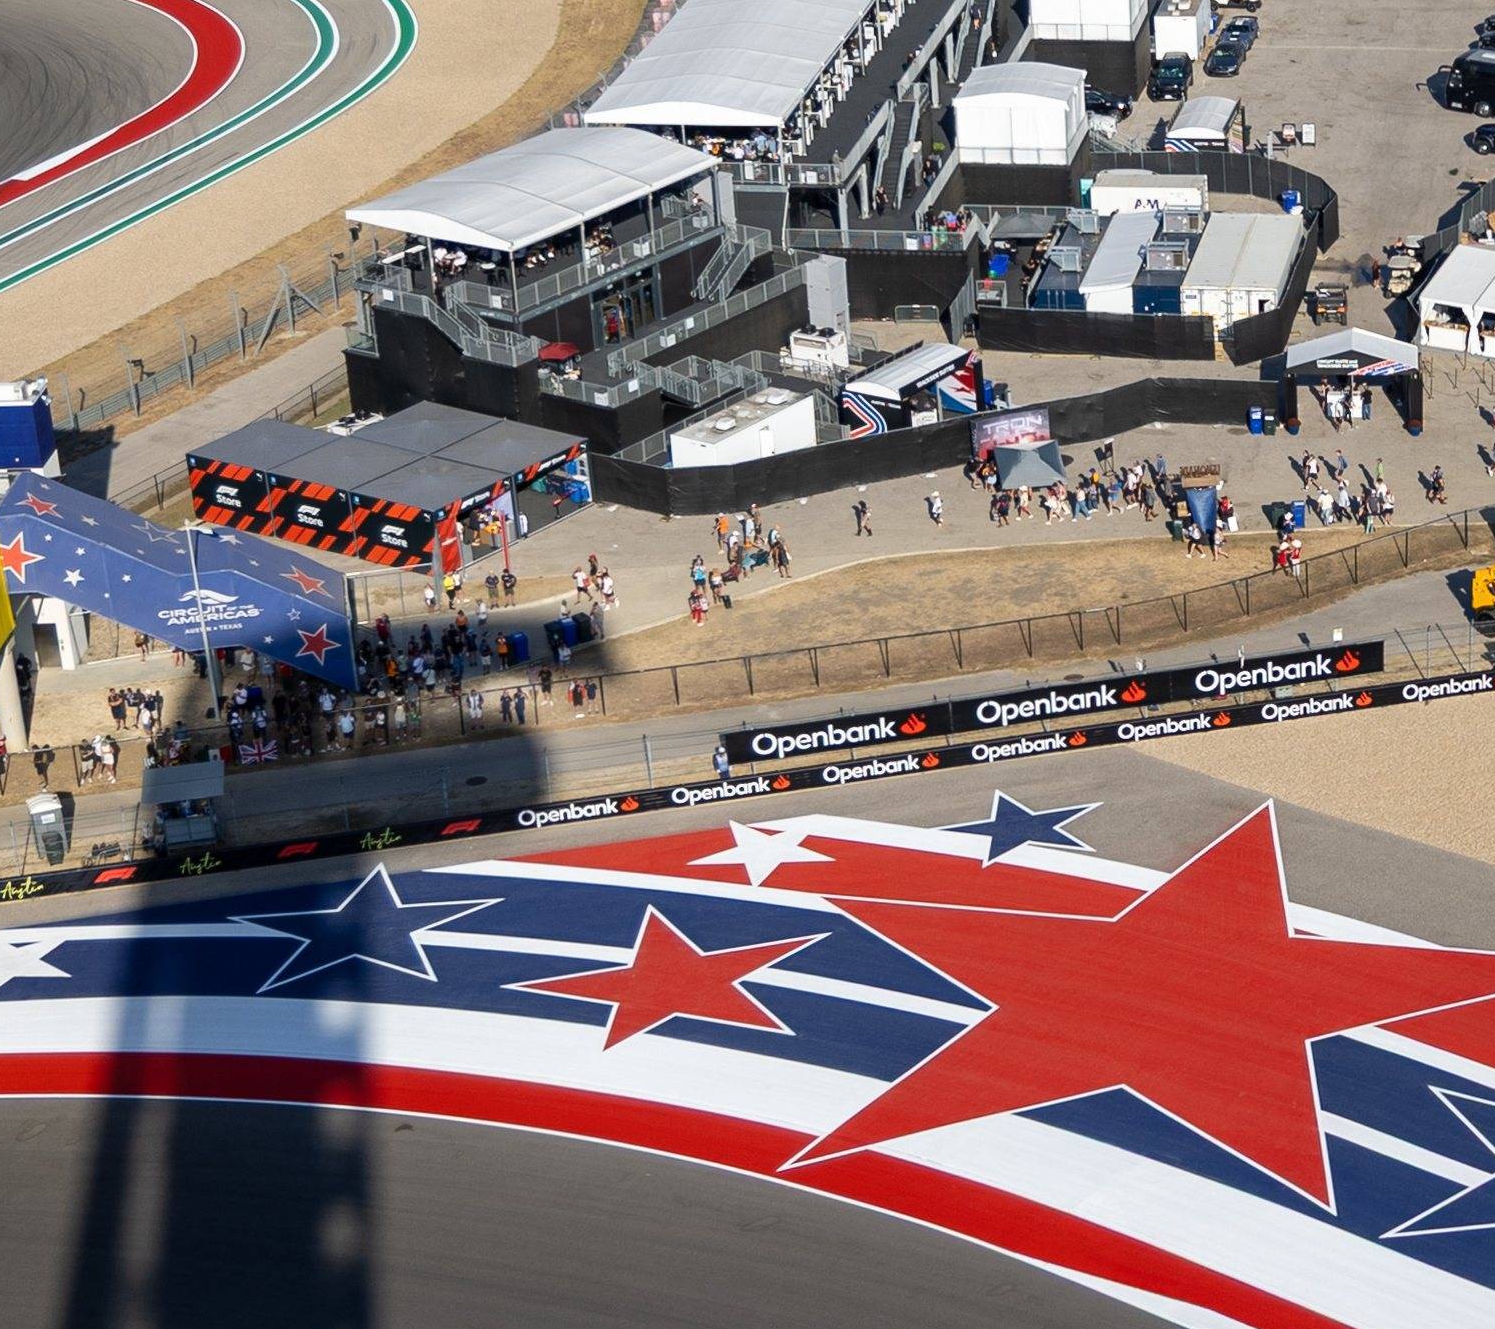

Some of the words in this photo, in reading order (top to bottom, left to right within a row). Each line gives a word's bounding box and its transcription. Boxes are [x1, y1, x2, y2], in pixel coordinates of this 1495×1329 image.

[982, 414, 1043, 436] TRON
[216, 493, 242, 509] Store
[298, 512, 324, 528] Store
[381, 533, 408, 549] Store
[157, 604, 228, 619] CIRCUIT
[1195, 652, 1333, 696] Openbank
[1401, 672, 1494, 702] Openbank
[976, 681, 1118, 727] Openbank
[1260, 692, 1355, 723] Openbank
[751, 717, 897, 760] Openbank
[1116, 712, 1213, 742] Openbank
[971, 732, 1068, 763] Openbank
[821, 753, 921, 785] Openbank
[671, 776, 772, 807] Openbank
[517, 797, 619, 829] Openbank
